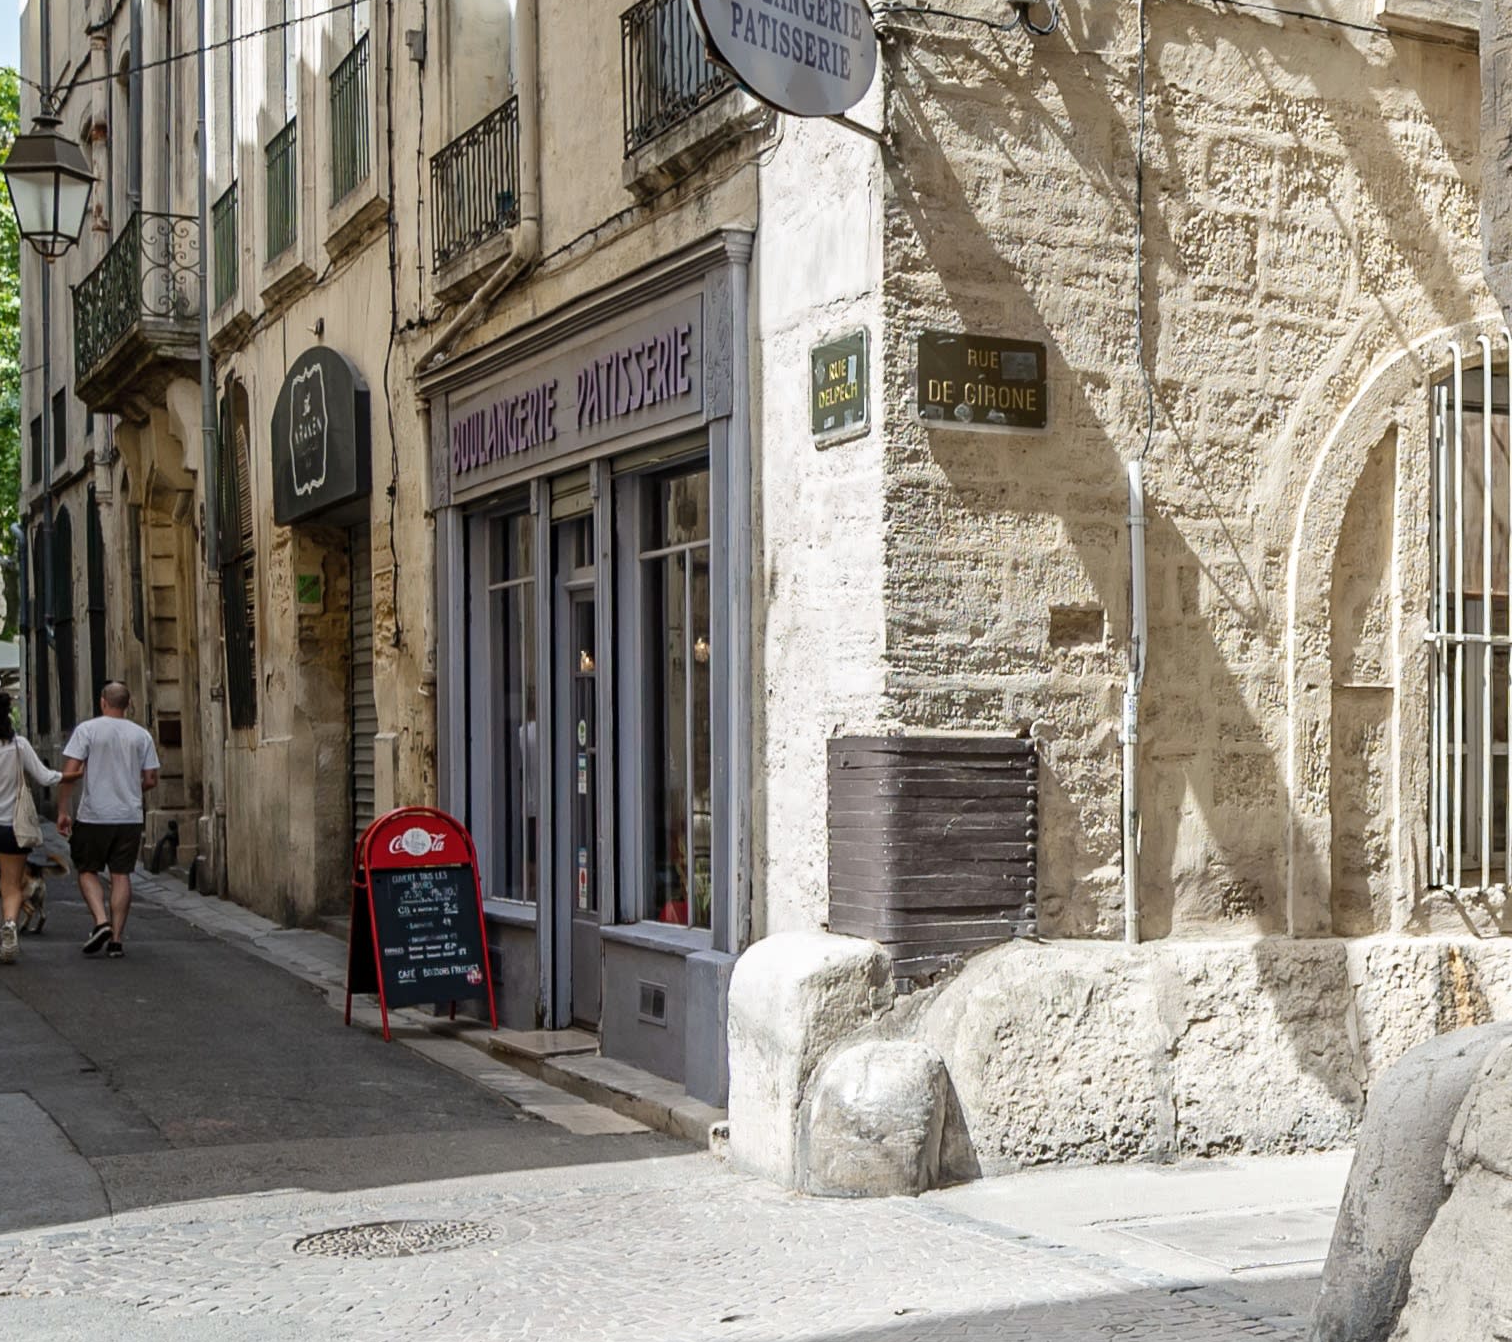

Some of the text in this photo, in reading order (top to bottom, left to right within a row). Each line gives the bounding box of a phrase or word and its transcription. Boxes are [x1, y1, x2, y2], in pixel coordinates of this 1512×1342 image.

[731, 1, 851, 81] PATISSERIE
[828, 358, 847, 381] RUE
[967, 349, 999, 369] RUE
[453, 323, 692, 476] BOULANGERIE PATISSERIE
[818, 382, 858, 409] DELPECH
[928, 379, 1036, 411] DE GIRONE
